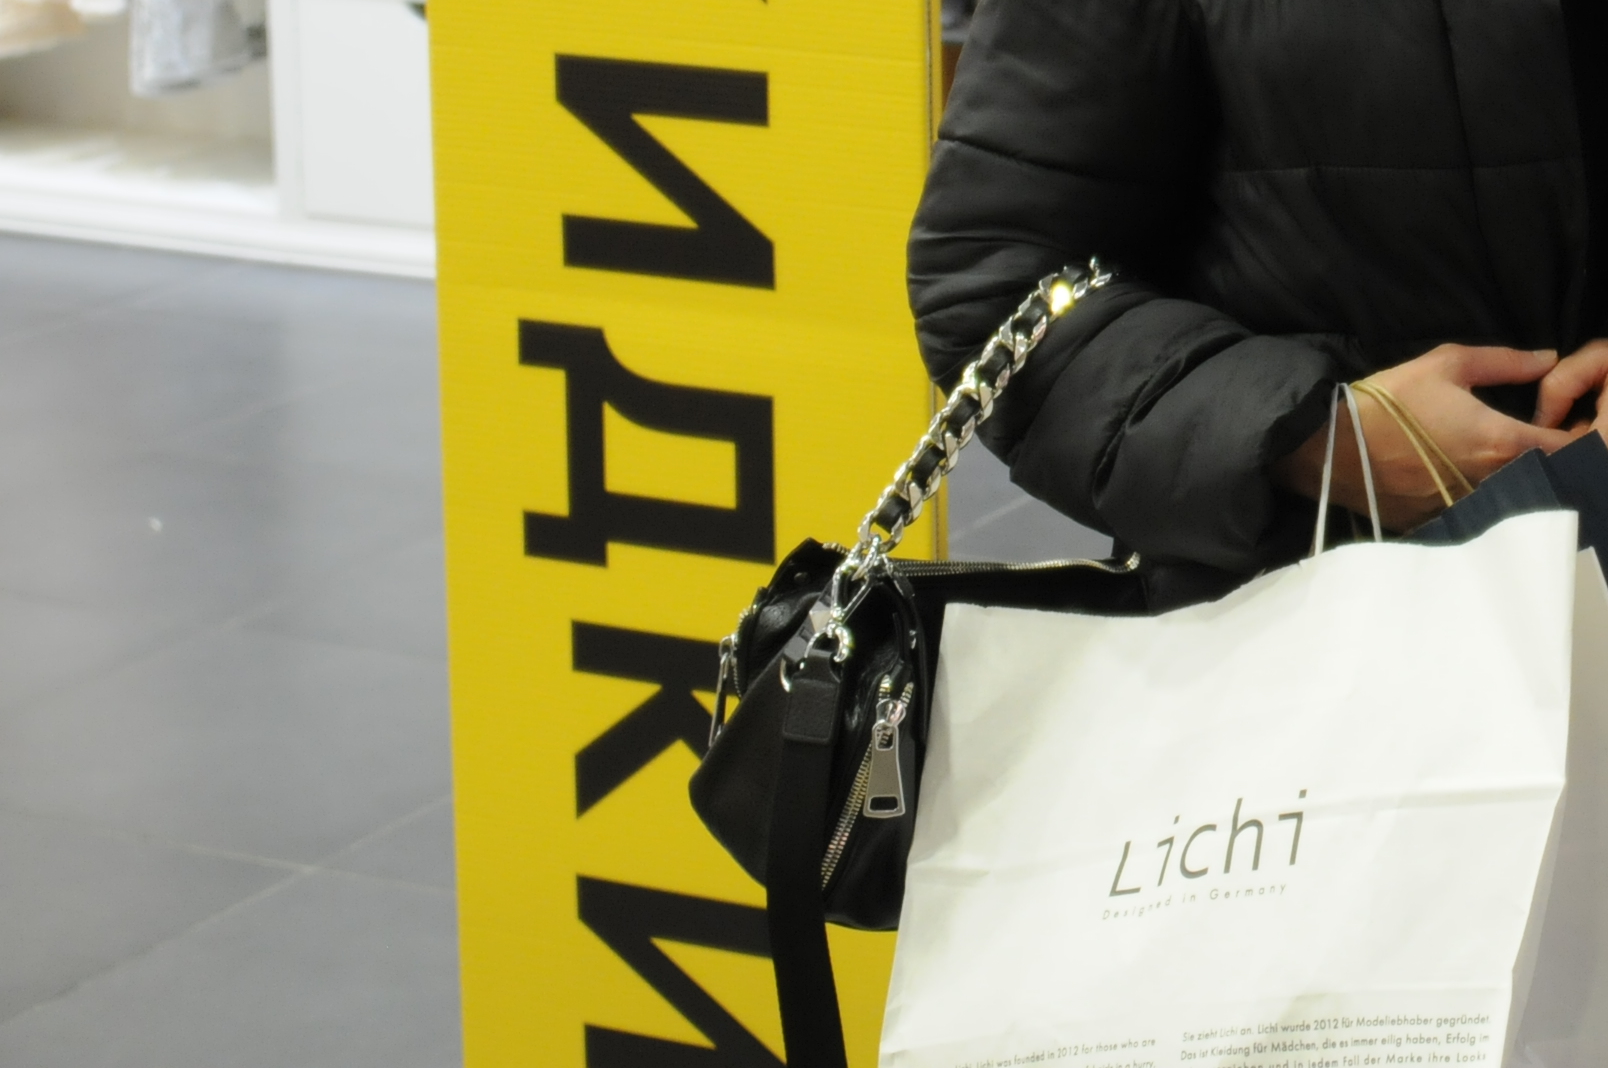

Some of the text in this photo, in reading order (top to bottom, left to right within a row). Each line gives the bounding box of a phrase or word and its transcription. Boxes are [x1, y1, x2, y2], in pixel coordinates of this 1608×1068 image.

[1109, 789, 1307, 897] Lichi
[1102, 883, 1287, 920] Designed in Germany
[1182, 1032, 1195, 1042] Sie
[1197, 1029, 1218, 1041] zieht
[1219, 1025, 1238, 1038] Lichi
[1257, 1022, 1279, 1034] Lichi
[1280, 1020, 1311, 1032] wurde
[1313, 1018, 1339, 1030] 2012
[1341, 1016, 1354, 1028] für
[1356, 1014, 1433, 1027] Modeliebhaber
[996, 1060, 1012, 1068] was
[1014, 1051, 1045, 1066] founded
[1047, 1050, 1056, 1060] in
[1057, 1045, 1079, 1059] 2012
[1081, 1043, 1094, 1055] for
[1095, 1042, 1118, 1053] those
[1121, 1038, 1139, 1049] who
[1142, 1038, 1156, 1047] are
[1180, 1032, 1490, 1061] Das ist Kleidung für Mädchen, die es immer eilig haben, Erfolg im
[1343, 1054, 1360, 1067] Fall
[1363, 1054, 1381, 1066] der
[1386, 1052, 1422, 1064] Marke
[1428, 1051, 1451, 1063] ihre
[1456, 1051, 1486, 1063] Looks
